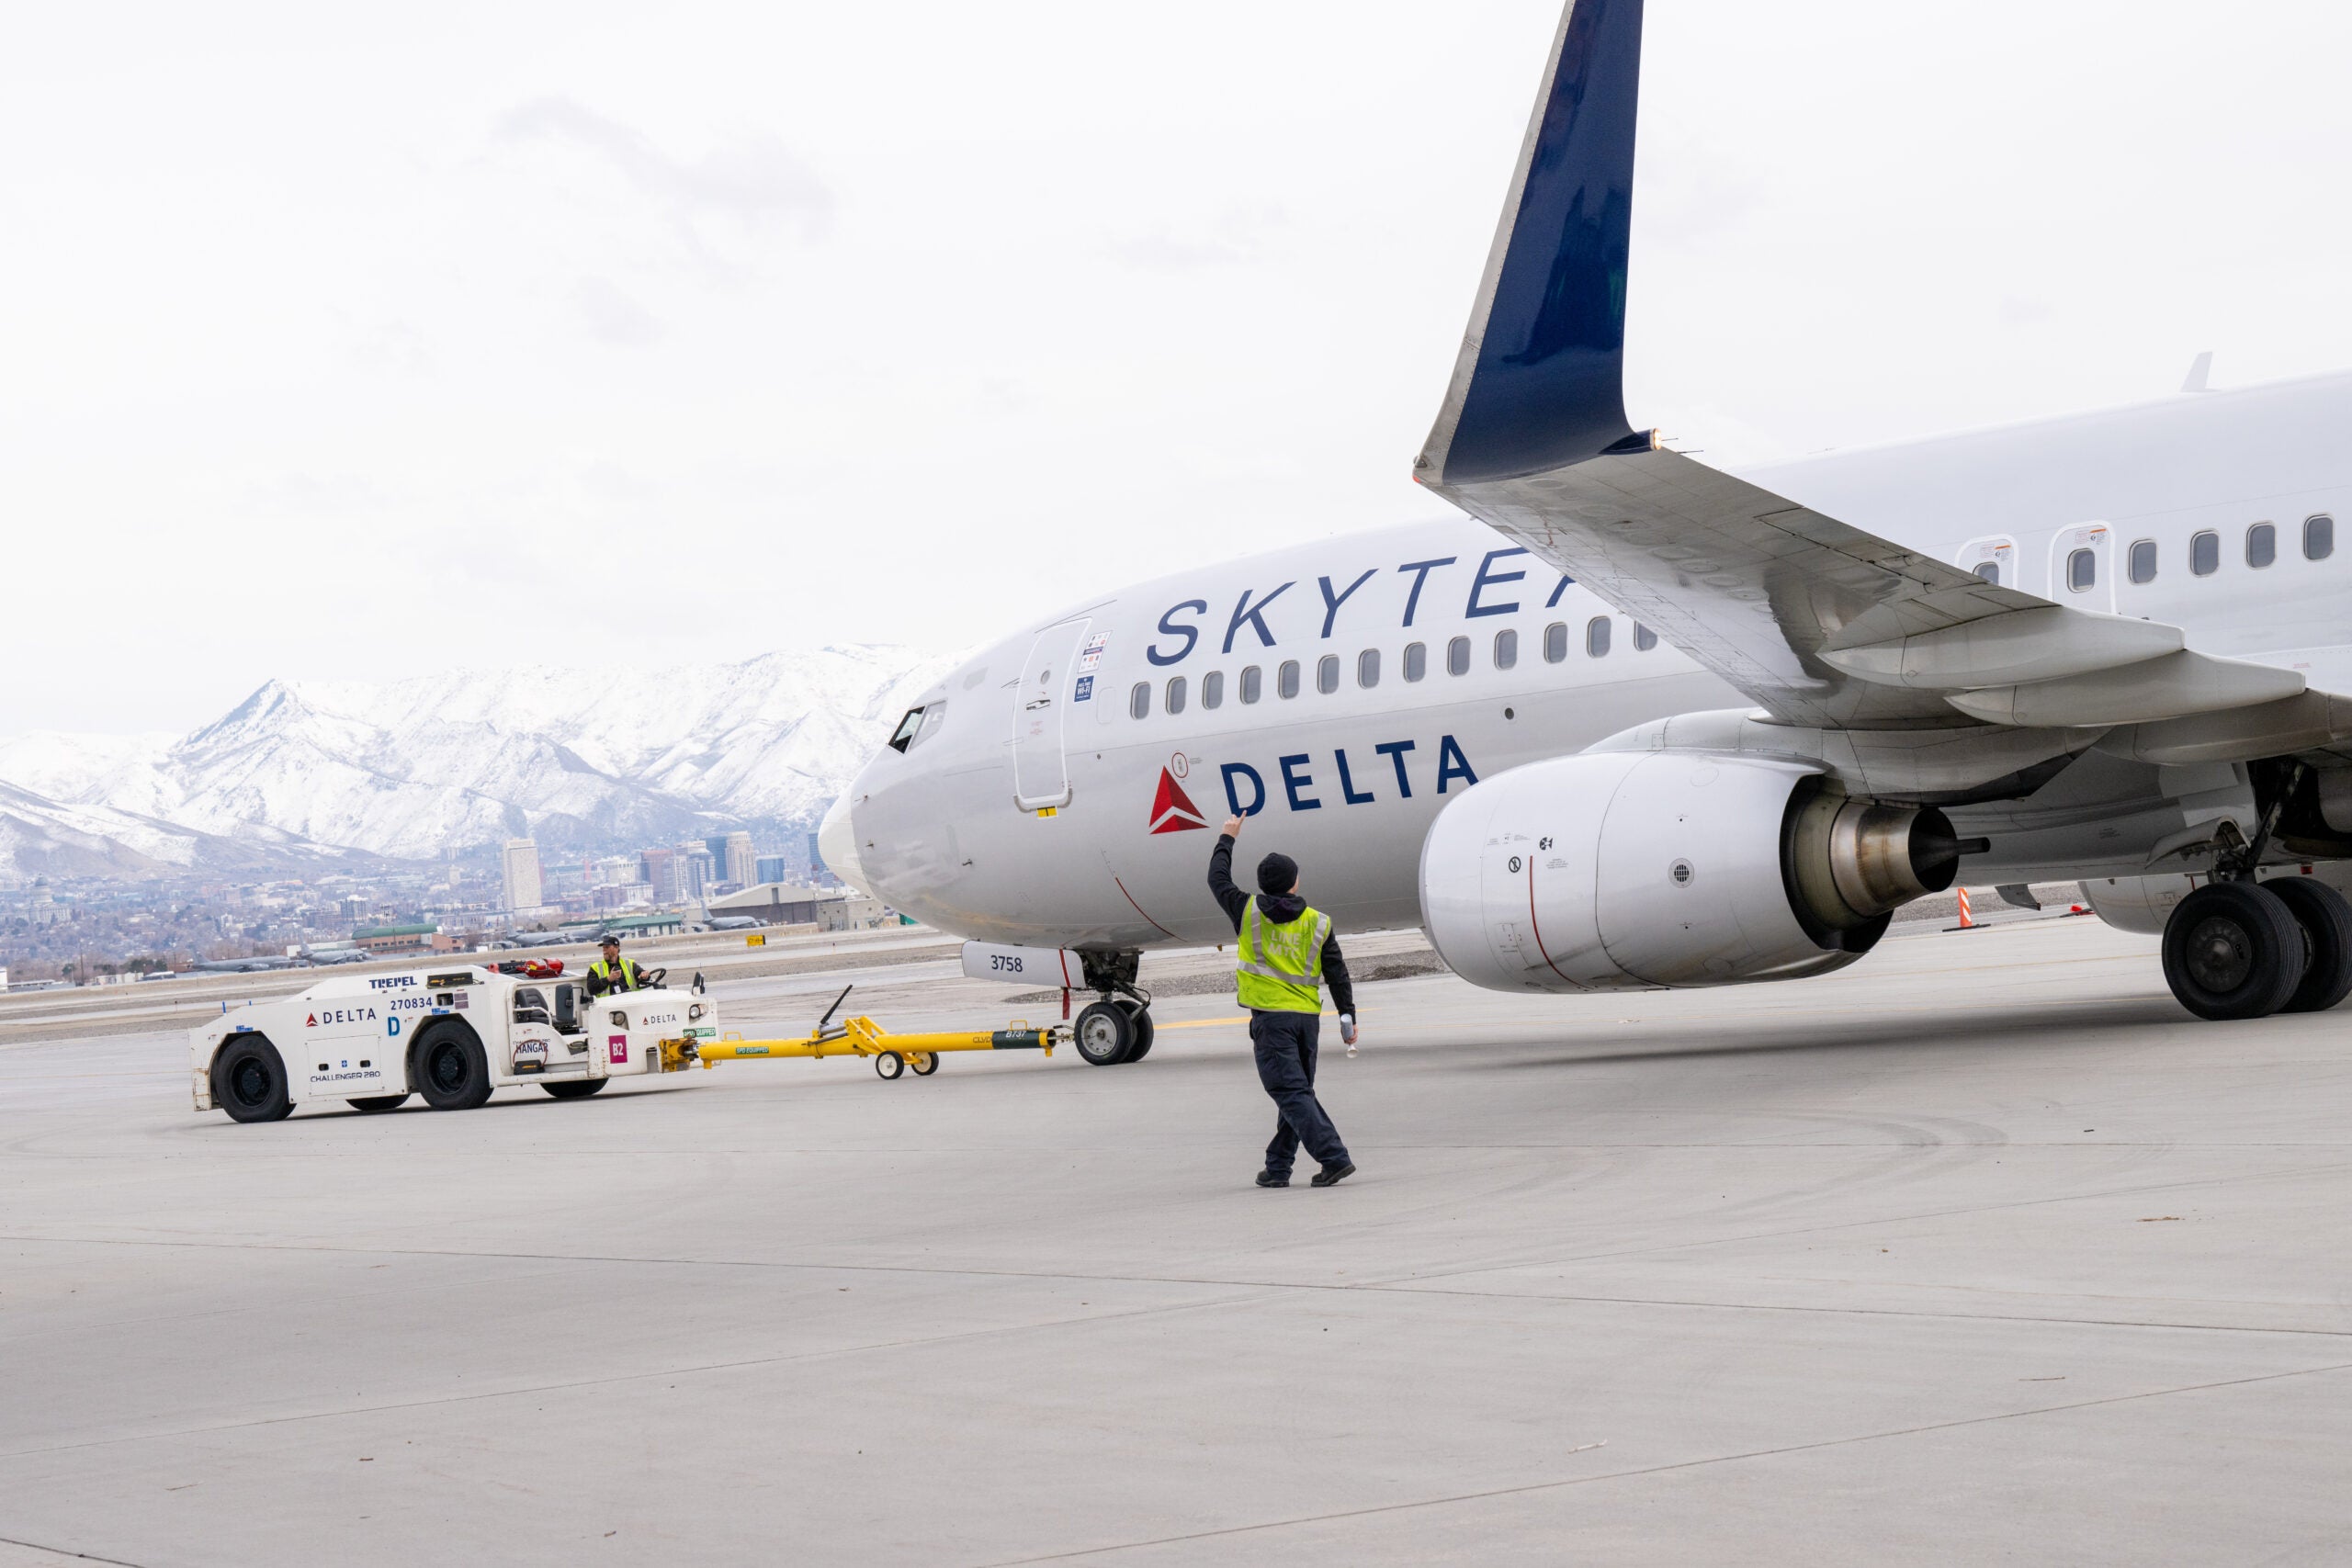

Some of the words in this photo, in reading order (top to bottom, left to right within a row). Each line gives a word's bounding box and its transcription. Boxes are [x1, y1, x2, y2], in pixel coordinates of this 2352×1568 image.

[1219, 734, 1479, 818] DELTA
[1271, 930, 1301, 945] LINE
[1268, 942, 1300, 959] MTC
[990, 954, 1023, 973] 3758
[368, 976, 417, 989] TREPEL
[390, 997, 433, 1010] 270834
[322, 1008, 377, 1024] DELTA
[650, 1014, 677, 1024] DELTA
[387, 1016, 401, 1036] D
[515, 1042, 548, 1055] HANGAR
[612, 1043, 624, 1056] B2
[310, 1072, 362, 1083] CHALLENGER
